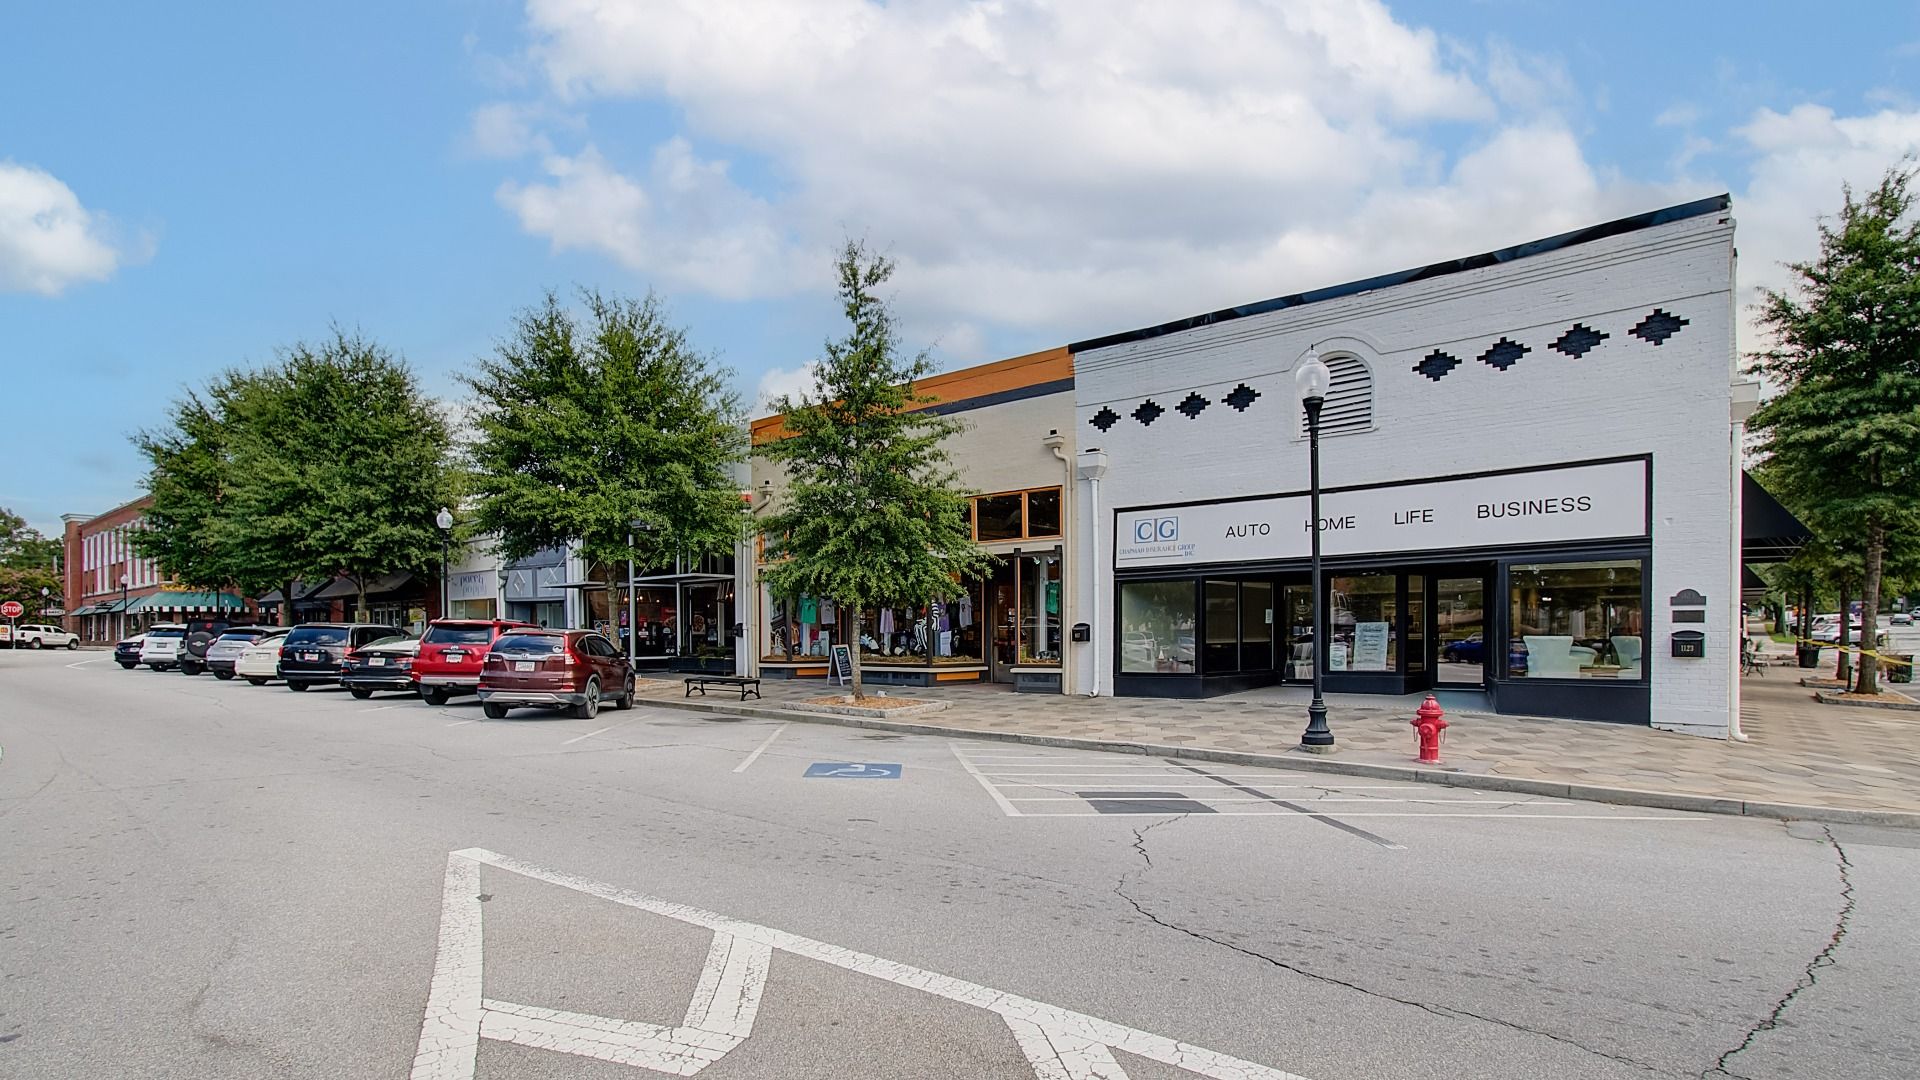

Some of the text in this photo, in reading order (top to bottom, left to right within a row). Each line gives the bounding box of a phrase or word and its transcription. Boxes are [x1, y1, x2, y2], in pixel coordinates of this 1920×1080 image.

[1225, 496, 1592, 538] AUTO HOME LIFE BUSINESS
[1136, 518, 1176, 543] CIG
[1680, 644, 1694, 652] 1123
